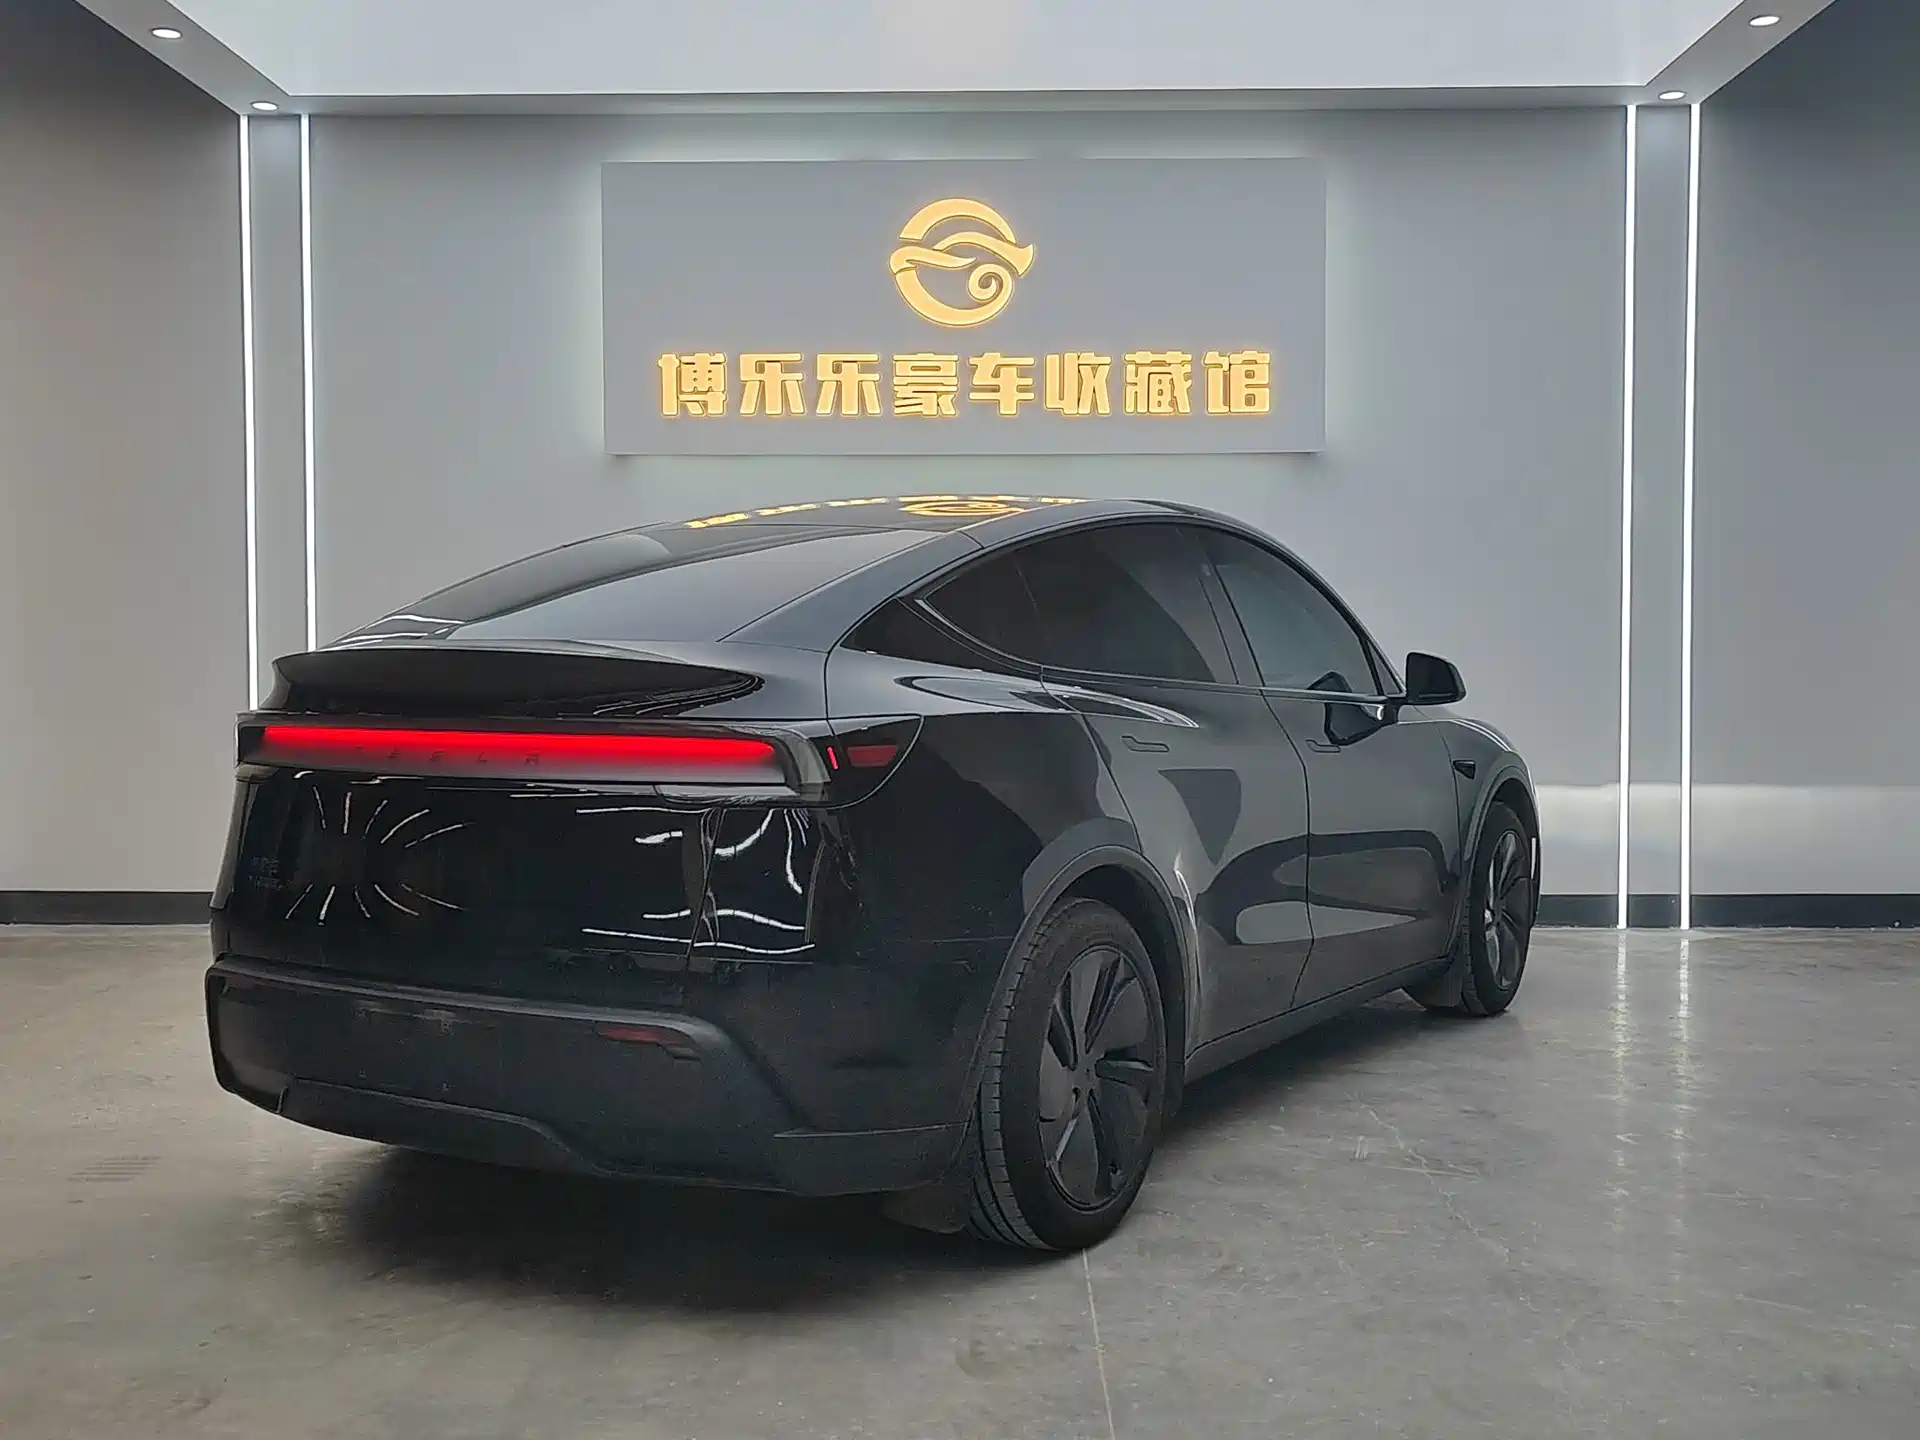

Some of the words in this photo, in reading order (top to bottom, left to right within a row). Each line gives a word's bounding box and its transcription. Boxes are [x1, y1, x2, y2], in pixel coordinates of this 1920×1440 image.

[657, 350, 1273, 418] 博乐乐豪车收藏馆
